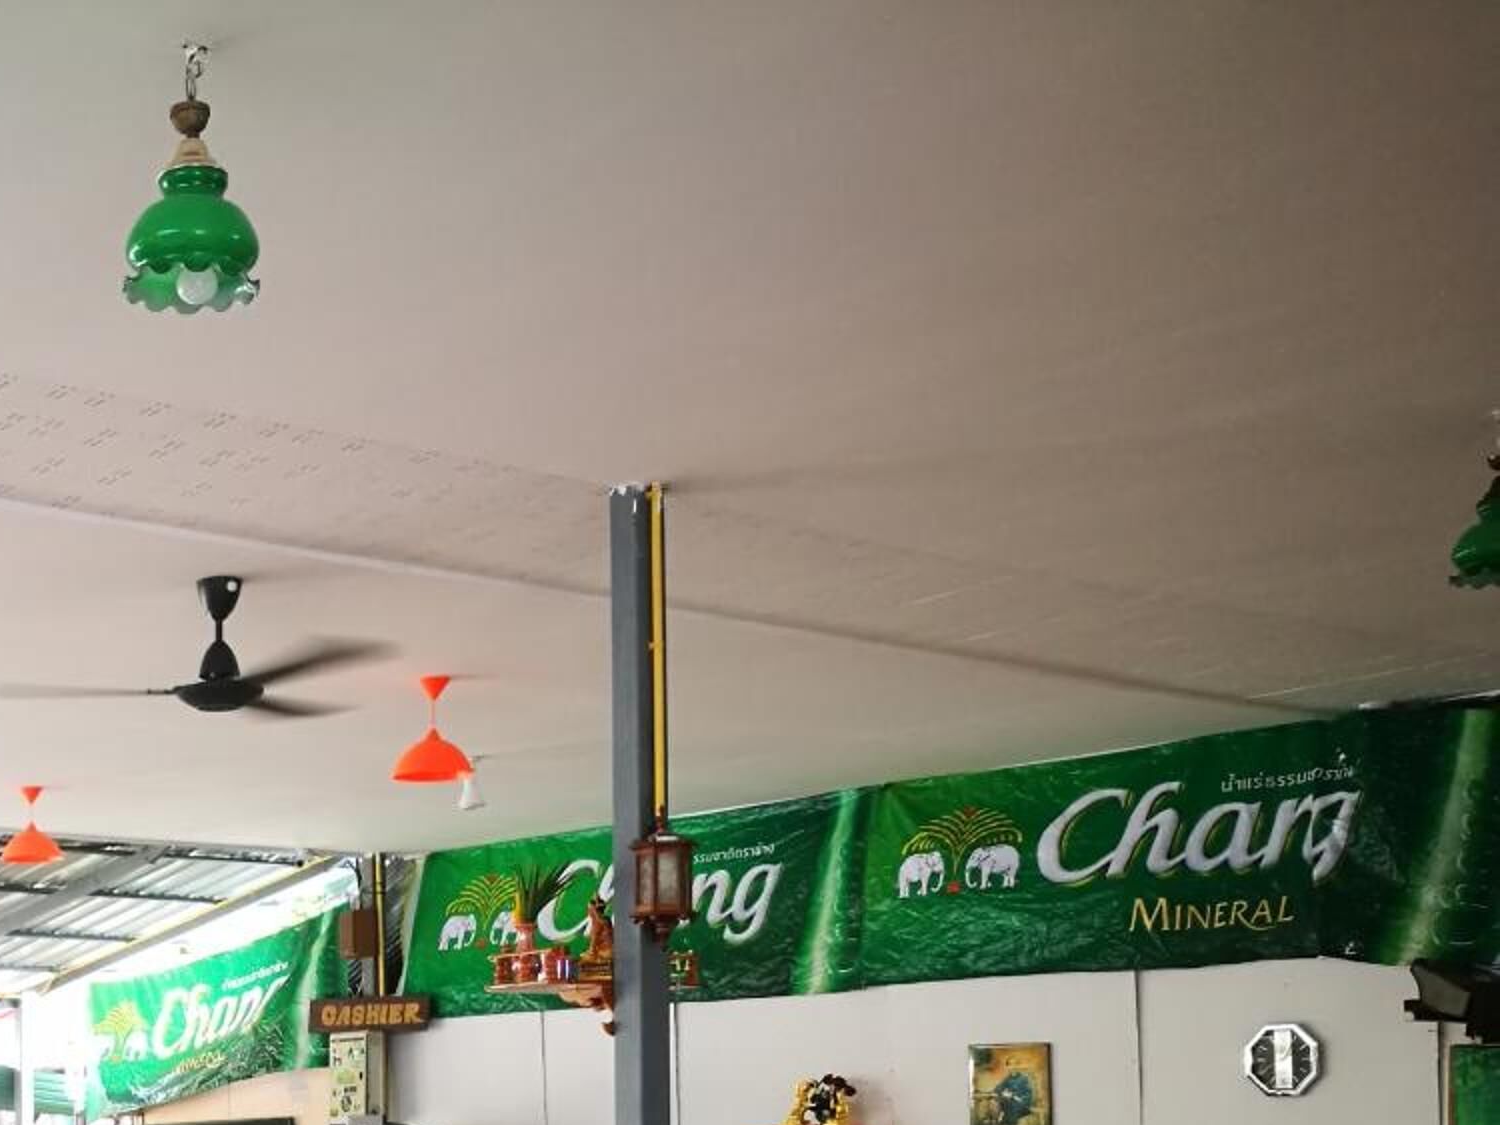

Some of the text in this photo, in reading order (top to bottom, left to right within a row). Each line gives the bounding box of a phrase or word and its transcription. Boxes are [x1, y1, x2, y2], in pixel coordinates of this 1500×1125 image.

[537, 858, 783, 944] Cng
[1129, 895, 1295, 932] MINERAL
[321, 1002, 425, 1026] CASHIER
